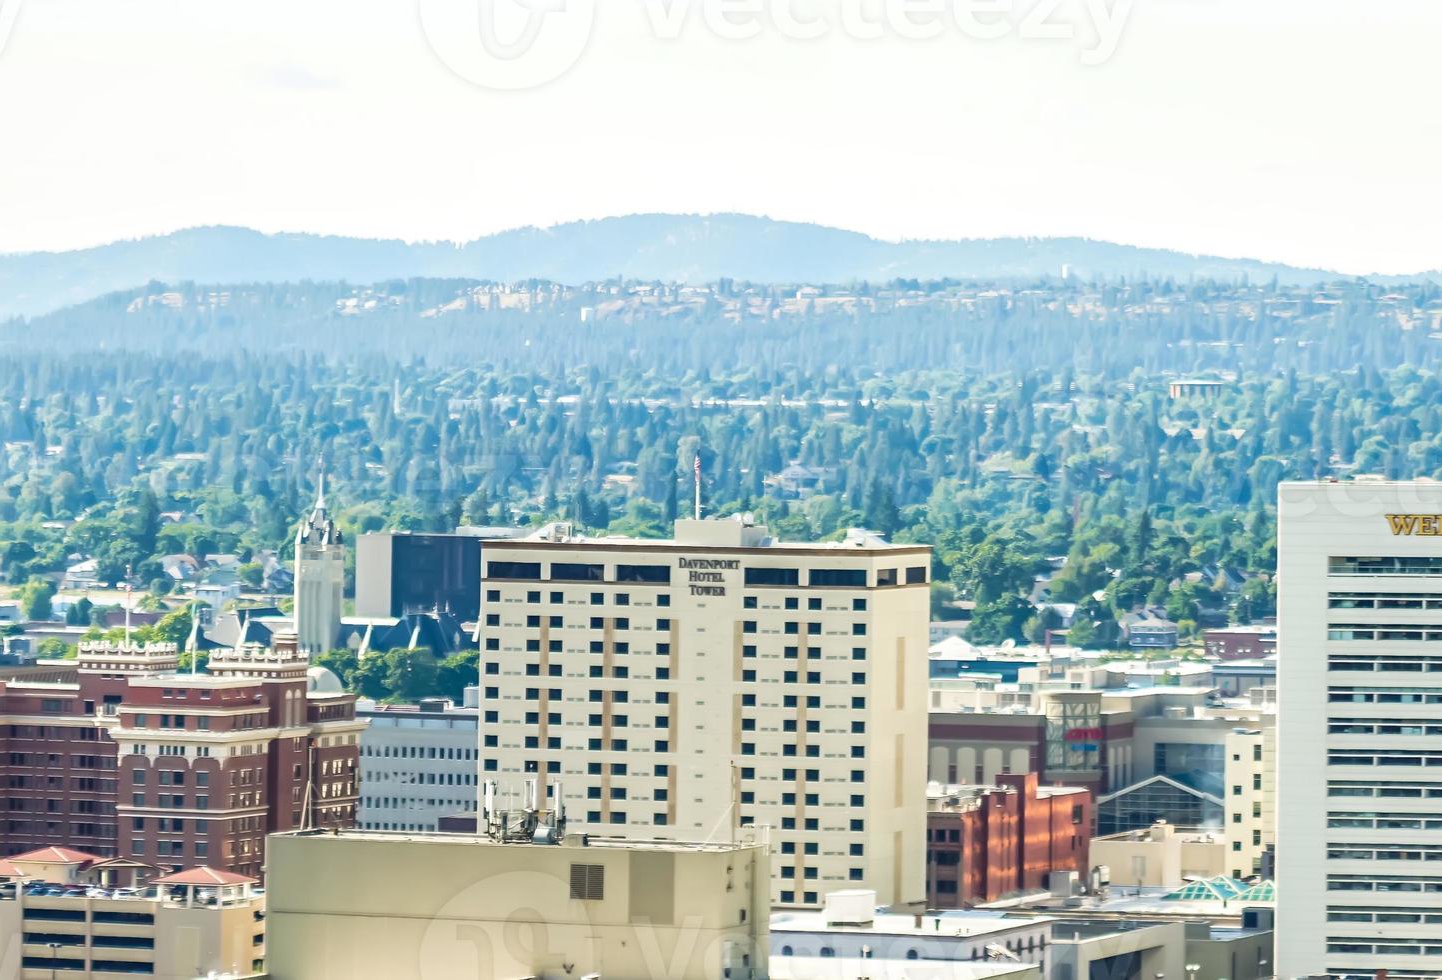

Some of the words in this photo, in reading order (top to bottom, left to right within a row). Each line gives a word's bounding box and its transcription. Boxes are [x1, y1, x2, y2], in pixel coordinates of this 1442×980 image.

[679, 557, 740, 569] DAVENPORT
[689, 571, 725, 582] HOTEL
[689, 585, 725, 596] TOWER
